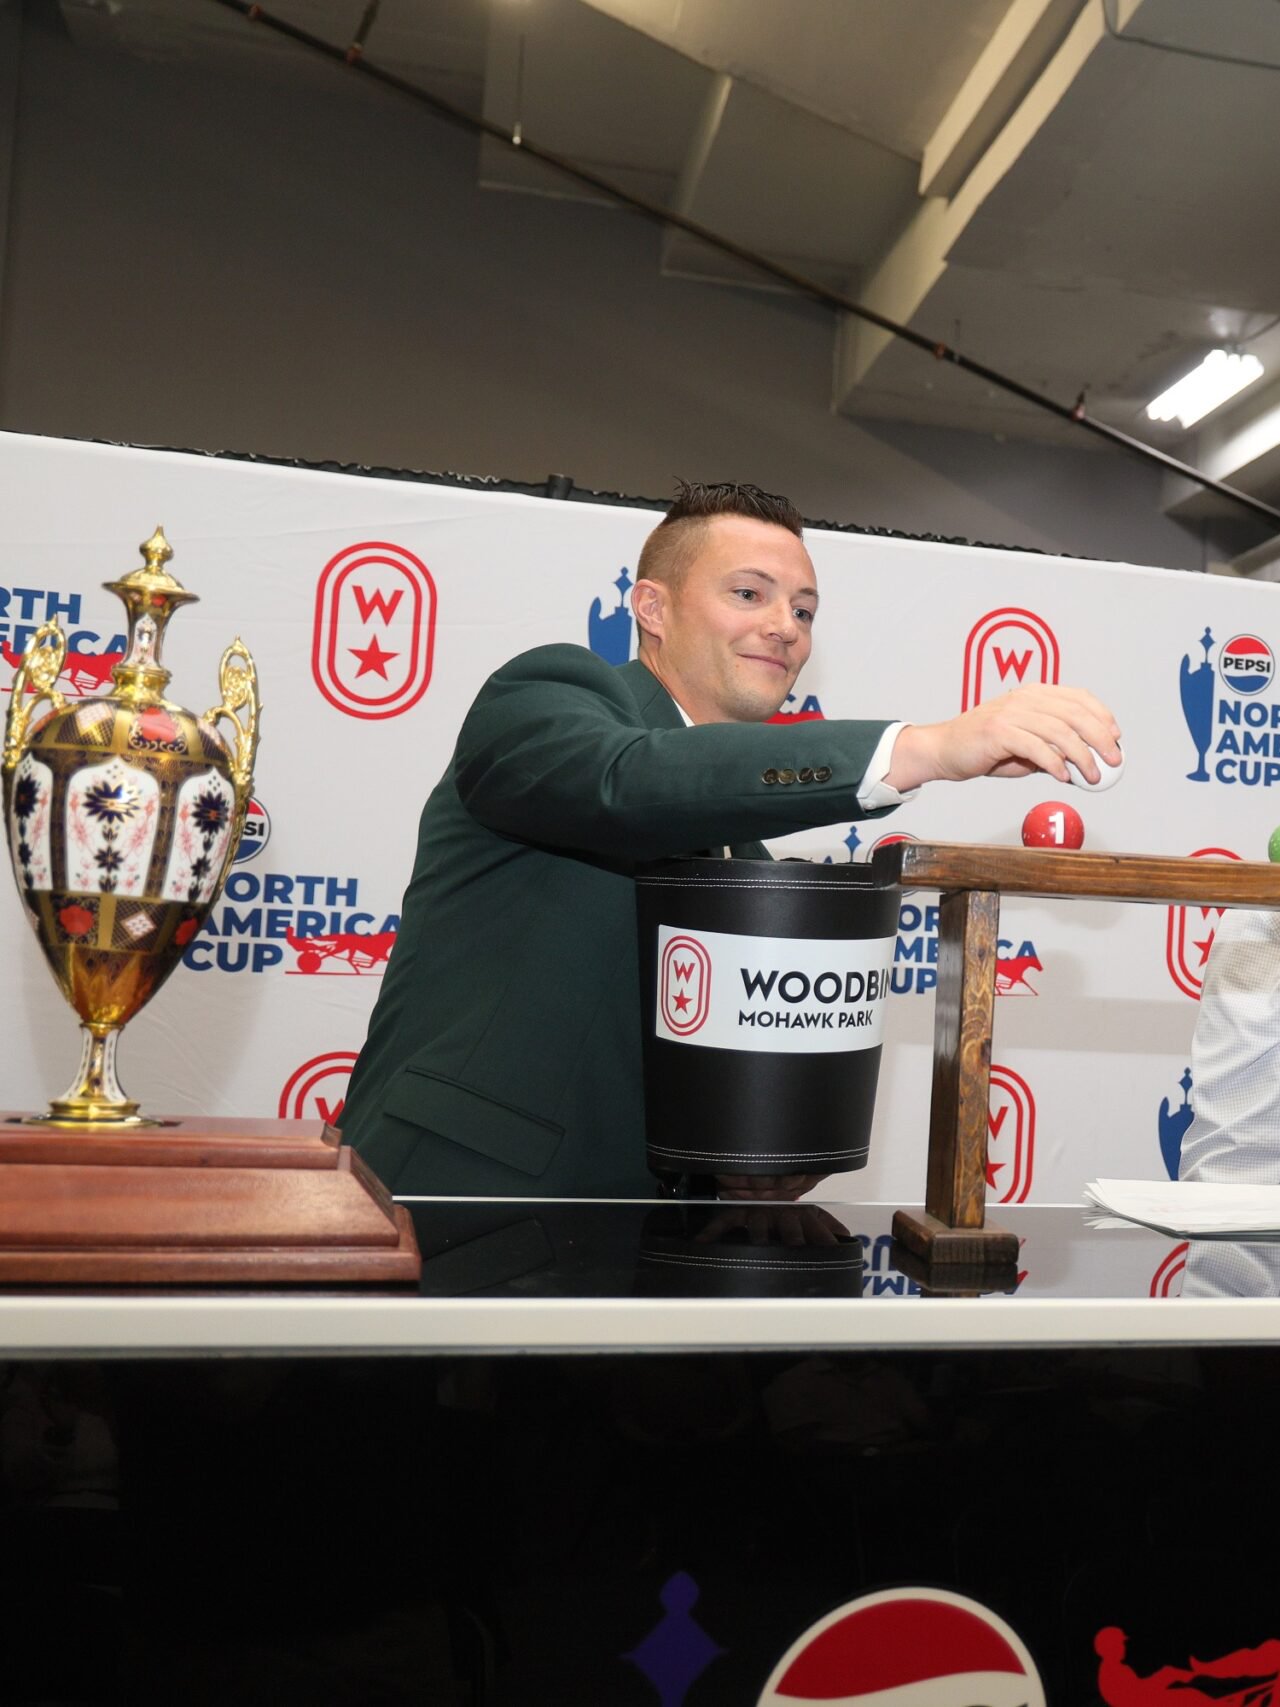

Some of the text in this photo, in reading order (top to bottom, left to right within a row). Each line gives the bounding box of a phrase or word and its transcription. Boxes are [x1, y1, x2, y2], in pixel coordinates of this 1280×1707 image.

[0, 586, 82, 625] RTH
[351, 584, 405, 626] W
[991, 645, 1034, 682] W
[1223, 657, 1270, 673] PEPSI
[1048, 811, 1065, 845] 1
[225, 872, 358, 907] ORTH
[182, 940, 284, 973] CUP
[673, 960, 696, 983] W
[890, 967, 939, 994] UP
[738, 1010, 873, 1029] MOHAWK PARK
